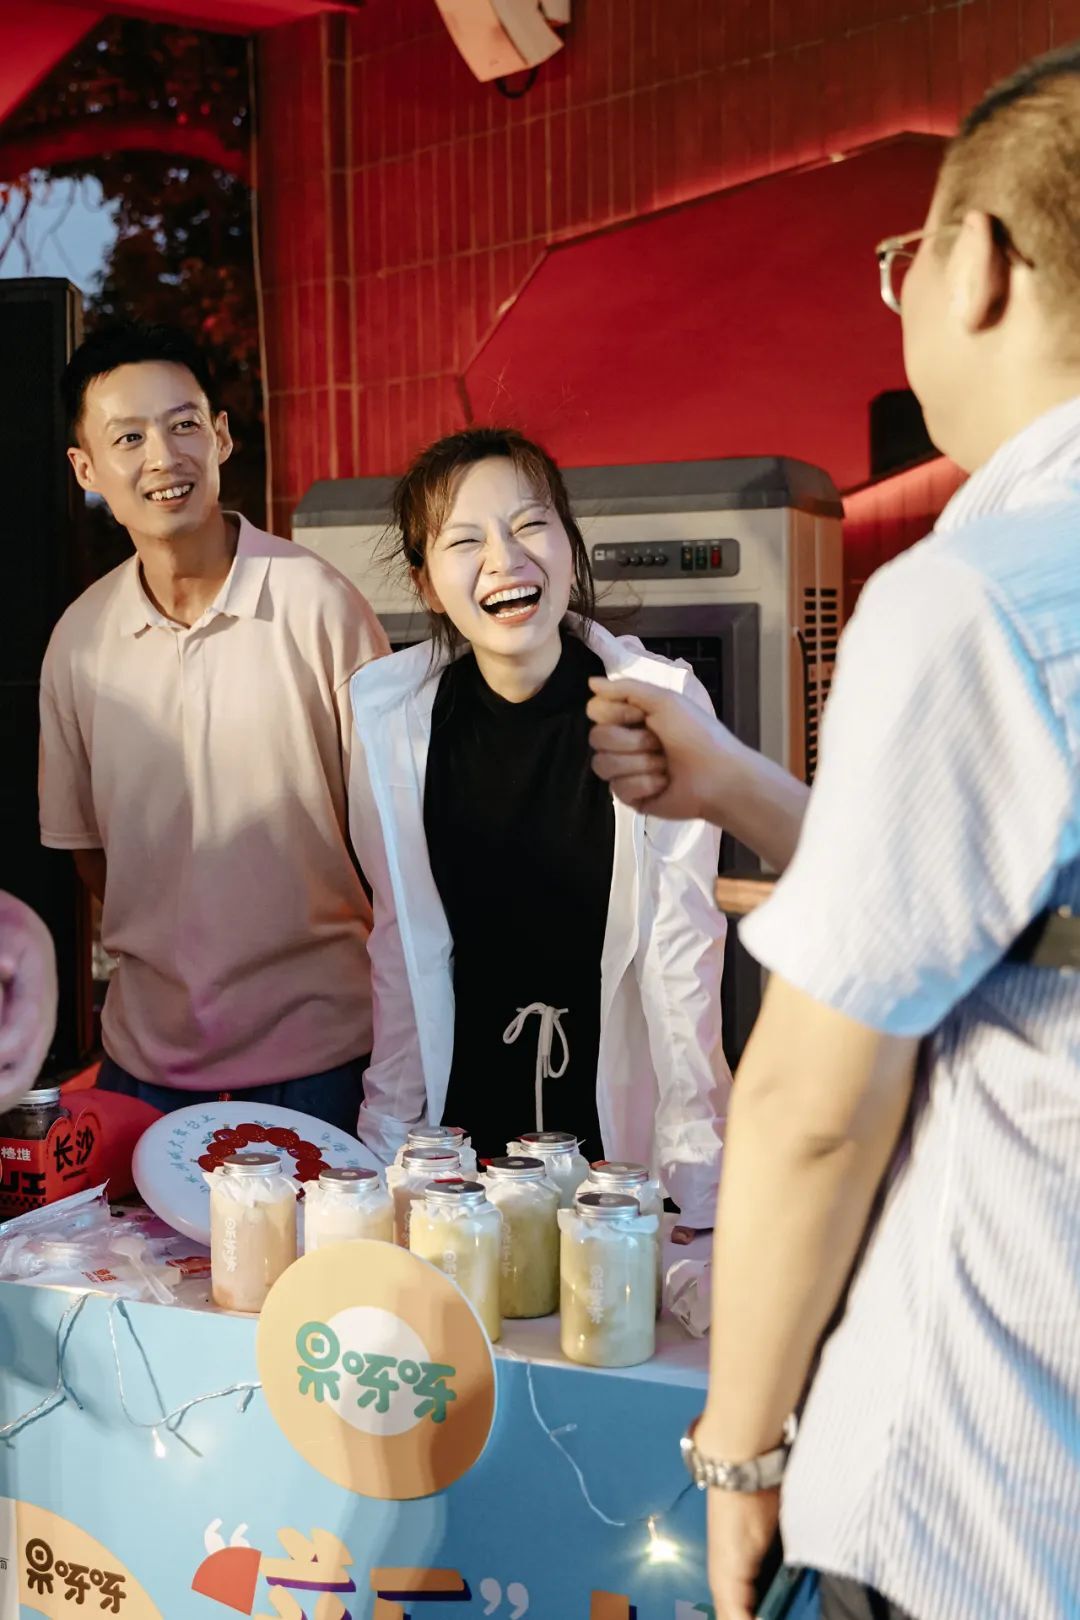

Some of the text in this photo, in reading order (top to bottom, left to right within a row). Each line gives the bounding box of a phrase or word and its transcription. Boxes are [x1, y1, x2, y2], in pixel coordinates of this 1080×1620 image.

[54, 1126, 95, 1173] 长沙
[296, 1321, 457, 1424] 果呀呀
[25, 1538, 127, 1614] 果呀呀
